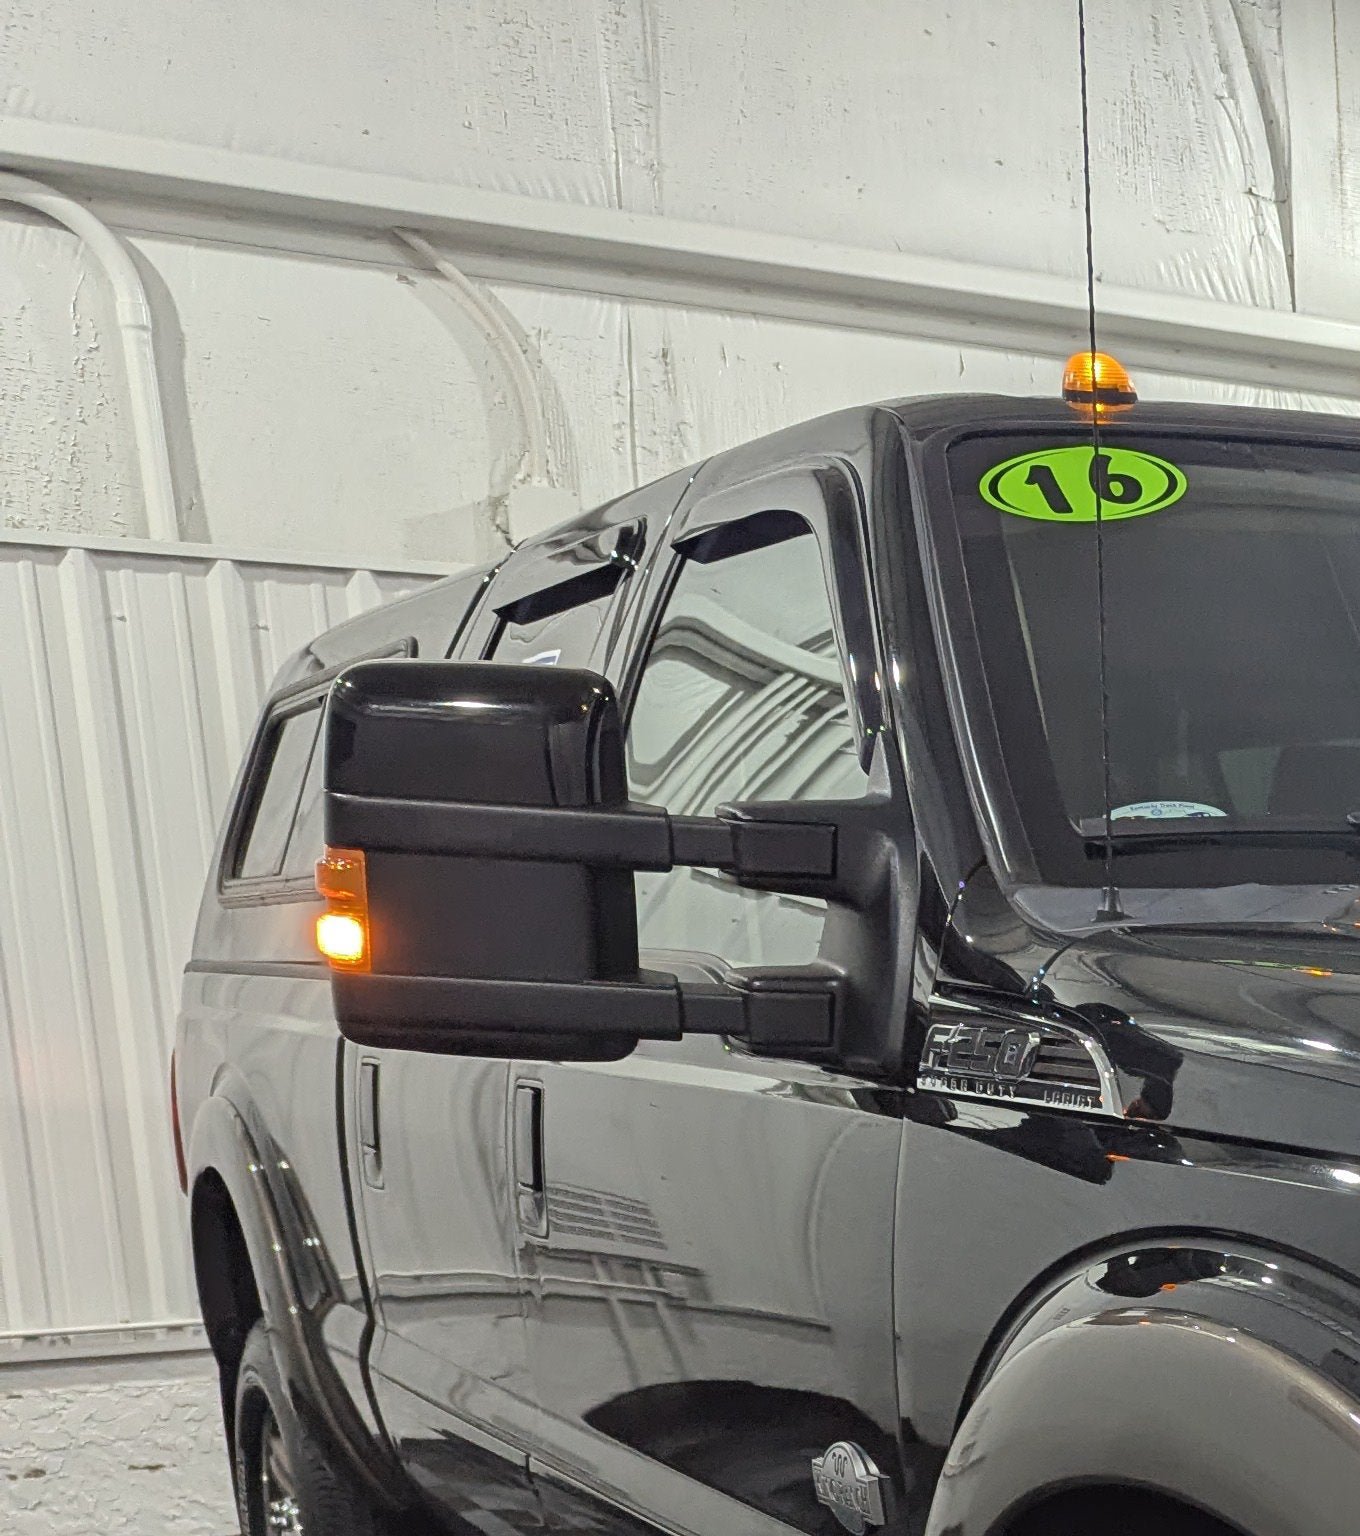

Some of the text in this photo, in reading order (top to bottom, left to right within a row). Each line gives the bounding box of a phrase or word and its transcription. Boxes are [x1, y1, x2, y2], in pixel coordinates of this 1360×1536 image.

[1024, 454, 1143, 514] 16
[975, 1080, 1017, 1099] DUTY
[1043, 1089, 1096, 1108] LARIAT
